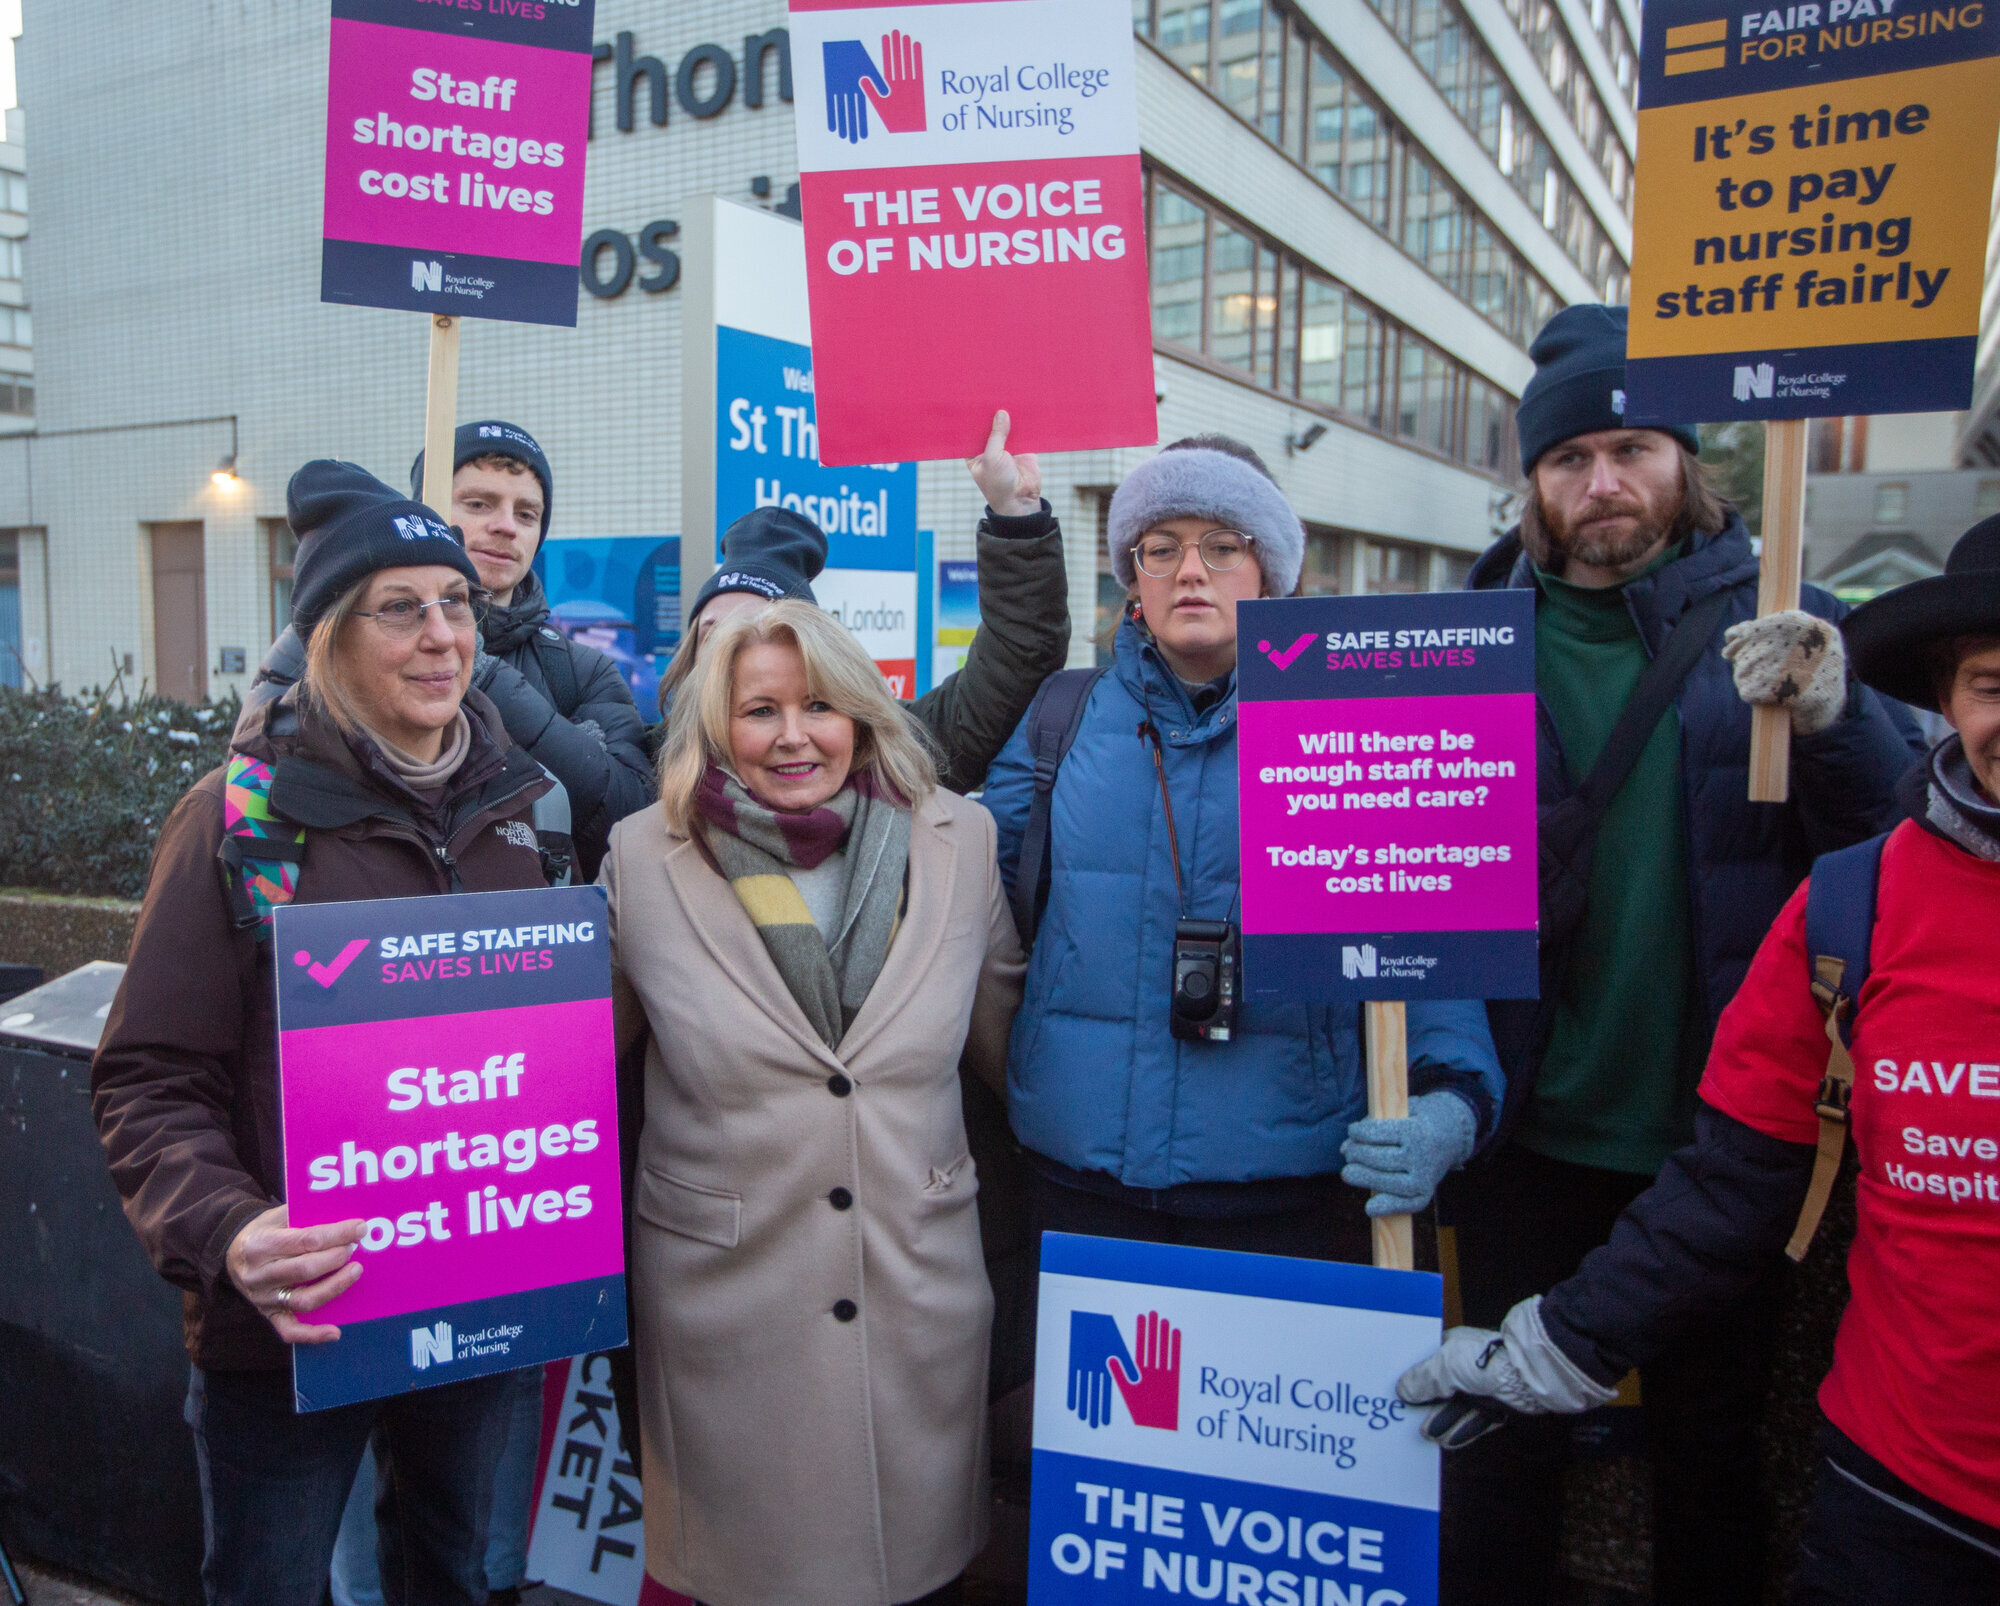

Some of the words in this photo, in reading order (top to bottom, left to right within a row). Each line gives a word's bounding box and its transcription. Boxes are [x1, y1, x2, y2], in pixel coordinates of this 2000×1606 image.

[489, 0, 545, 20] LIVES
[1742, 4, 1820, 37] FAIR
[1741, 34, 1806, 64] FOR
[1819, 3, 1983, 52] NURSING
[411, 68, 516, 111] Staff
[942, 66, 1009, 103] Royal
[1017, 63, 1109, 97] College
[943, 105, 968, 131] of
[977, 102, 1074, 135] Nursing
[1694, 119, 1775, 162] It's
[1790, 104, 1929, 149] time
[353, 112, 564, 169] shortages
[360, 170, 449, 203] cost
[460, 173, 553, 215] lives
[844, 189, 940, 227] THE
[952, 180, 1102, 220] VOICE
[1716, 178, 1773, 210] to
[1788, 164, 1896, 213] pay
[828, 238, 893, 275] OF
[909, 225, 1125, 270] NURSING
[1695, 213, 1911, 265] nursing
[446, 275, 467, 286] Royal
[467, 277, 494, 289] College
[455, 286, 483, 299] Nursing
[1656, 273, 1784, 319] staff
[1795, 262, 1950, 308] fairly
[783, 367, 815, 393] Wel
[1776, 387, 1788, 397] of
[1791, 385, 1830, 398] Nursing
[1778, 374, 1806, 390] Royal
[1808, 373, 1846, 385] College
[730, 399, 766, 453] St
[1326, 631, 1389, 650] SAFE
[1395, 627, 1514, 648] STAFFING
[1327, 651, 1402, 669] SAVES
[1410, 649, 1475, 667] LIVES
[1299, 732, 1353, 753] Will
[1360, 732, 1434, 752] there
[1441, 730, 1474, 750] be
[1260, 761, 1362, 786] enough
[1369, 758, 1432, 780] staff
[1437, 757, 1514, 778] when
[1287, 794, 1336, 815] you
[1344, 787, 1409, 808] need
[1416, 786, 1488, 807] care?
[495, 826, 528, 838] NORTH
[507, 836, 531, 846] FACE
[1267, 845, 1368, 870] Today's
[1375, 844, 1510, 867] shortages
[1326, 874, 1383, 892] cost
[1390, 870, 1451, 891] lives
[381, 933, 456, 958] SAFE
[462, 922, 594, 951] STAFFING
[382, 957, 471, 983] SAVES
[481, 950, 553, 974] LIVES
[1380, 968, 1390, 977] of
[1391, 967, 1425, 979] Nursing
[1381, 956, 1404, 968] Royal
[1405, 956, 1437, 968] College
[388, 1053, 525, 1110] Staff
[310, 1119, 598, 1192] shortages
[1903, 1127, 1998, 1159] Save
[353, 1202, 451, 1251] ost
[468, 1185, 592, 1234] lives
[458, 1329, 486, 1345] Royal
[487, 1325, 523, 1339] College
[458, 1347, 469, 1359] of
[470, 1341, 510, 1356] Nursing
[1201, 1367, 1280, 1411] Royal
[1290, 1378, 1406, 1430] College
[552, 1354, 614, 1530] CKET
[1197, 1409, 1229, 1439] of
[1238, 1414, 1356, 1469] Nursing
[1076, 1482, 1184, 1538] THE
[1201, 1502, 1383, 1574] VOICE
[1051, 1533, 1126, 1579] OF
